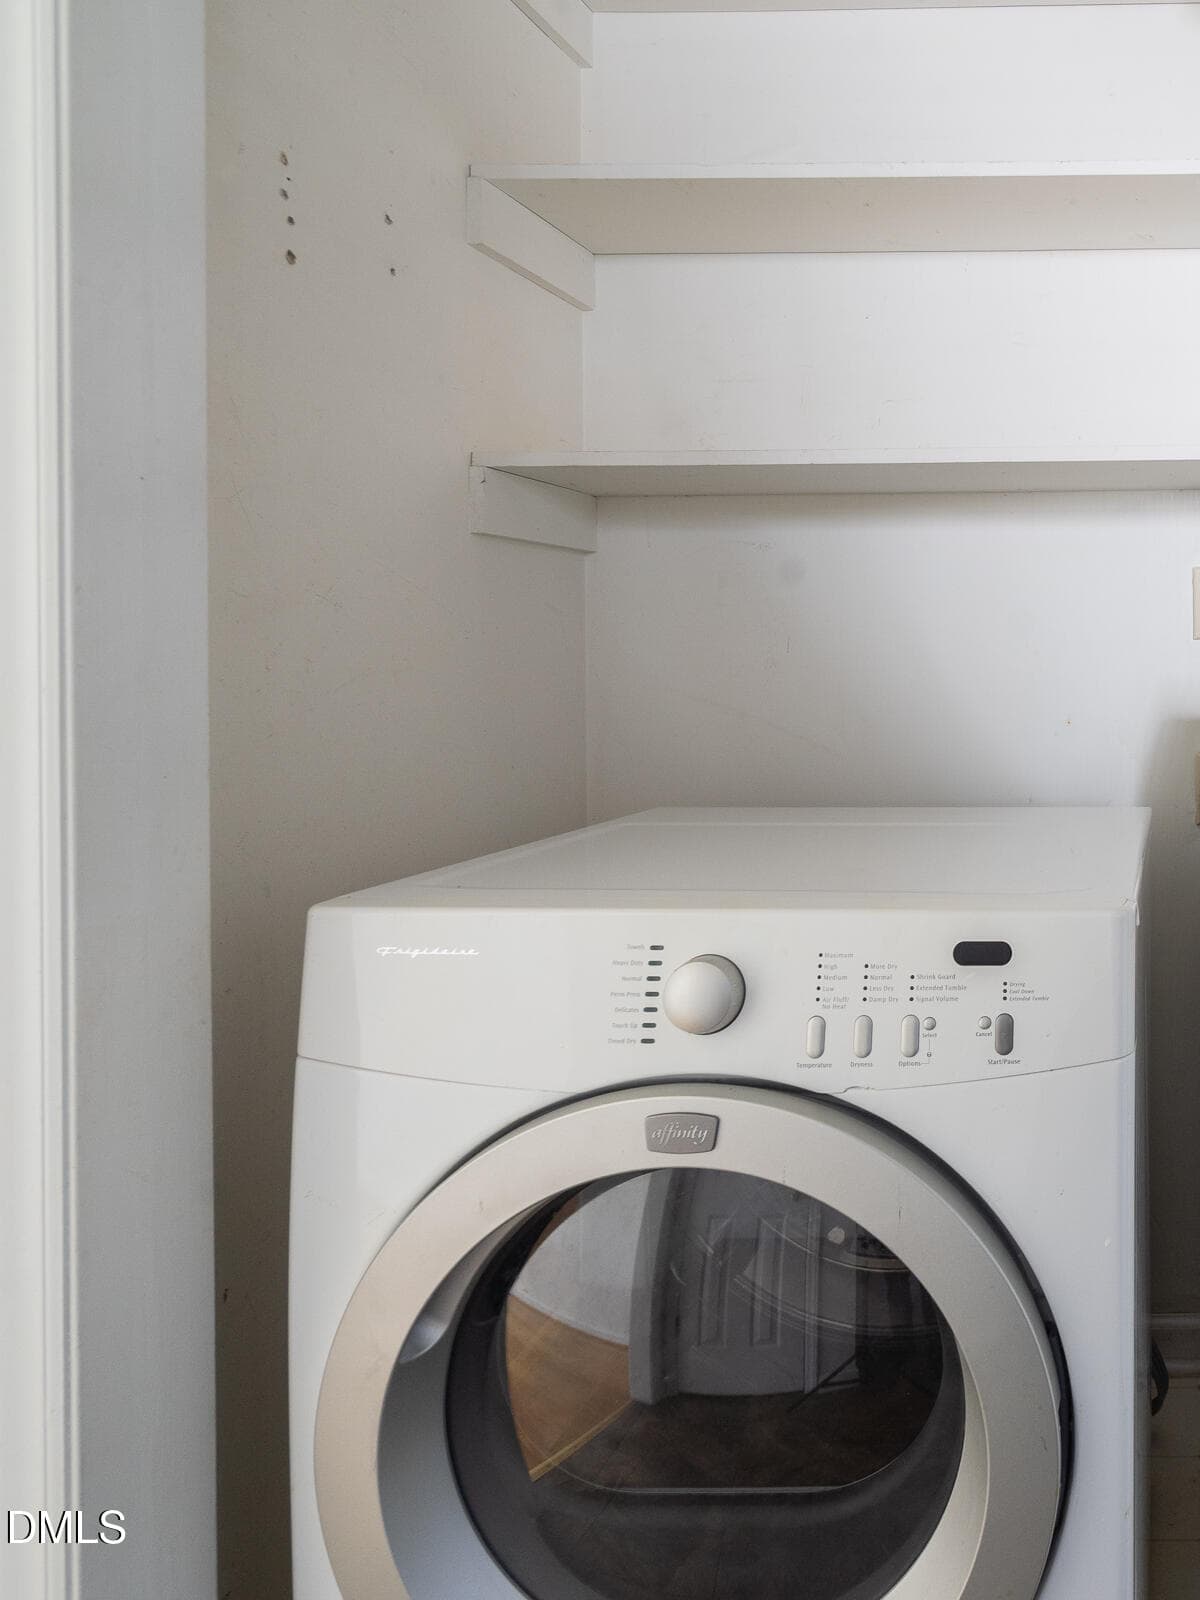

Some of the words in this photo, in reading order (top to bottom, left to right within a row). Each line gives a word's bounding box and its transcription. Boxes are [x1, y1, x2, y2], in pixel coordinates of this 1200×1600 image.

[796, 1061, 832, 1069] Temperature
[849, 1060, 874, 1068] Dryness
[898, 1060, 922, 1068] Options
[651, 1121, 708, 1145] affinity
